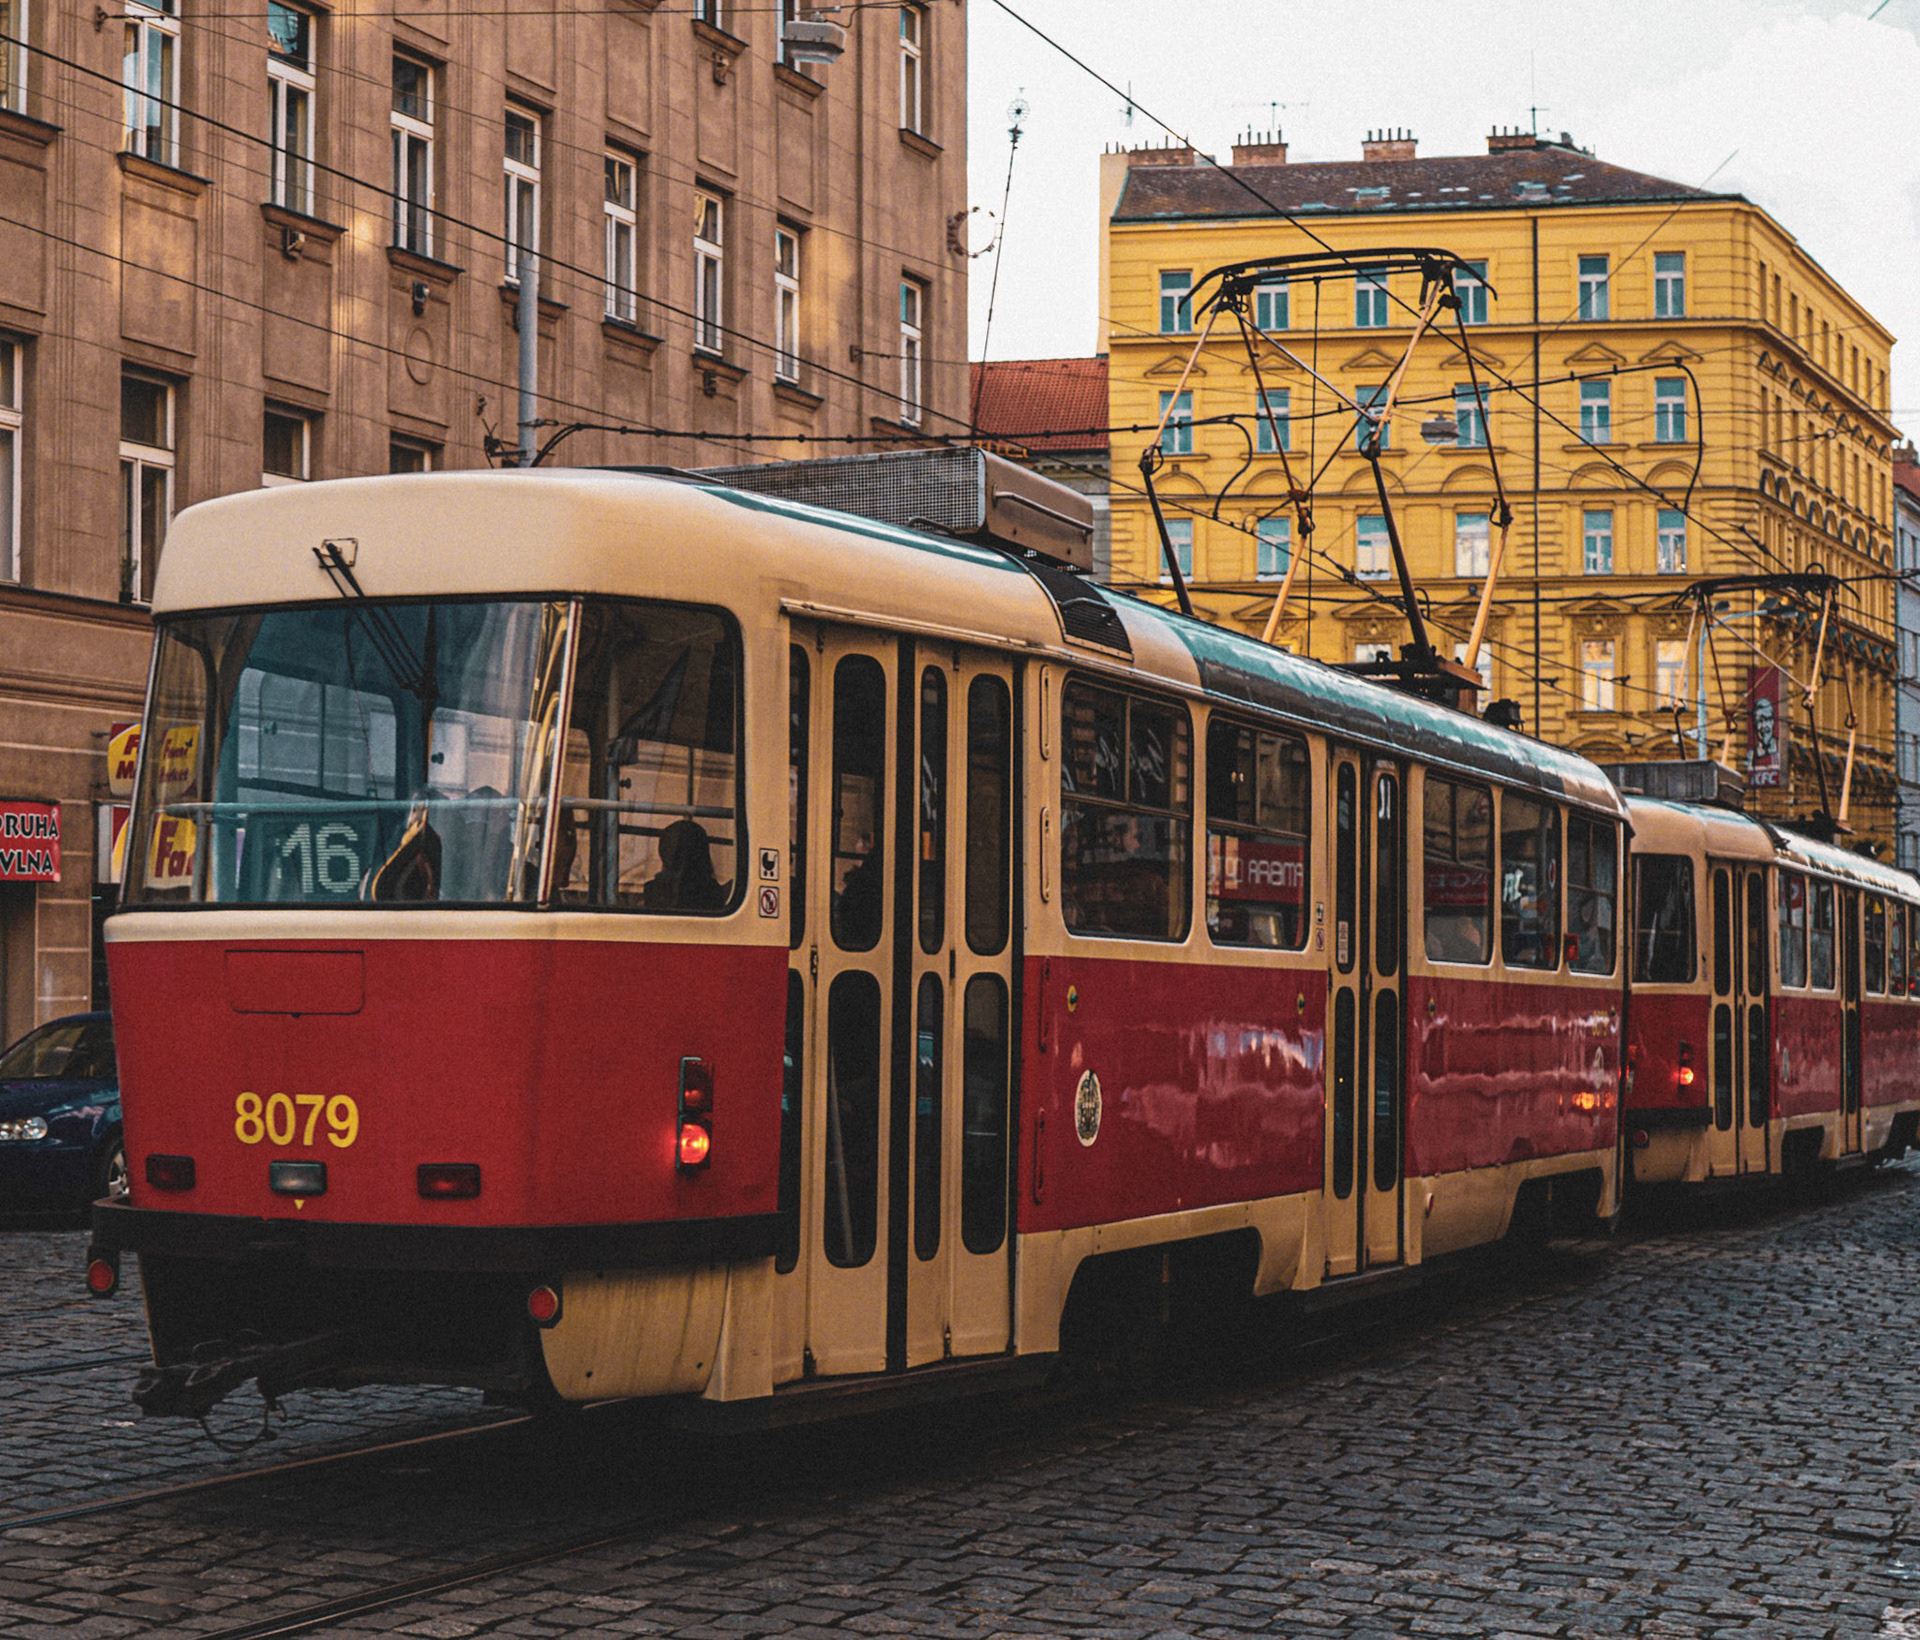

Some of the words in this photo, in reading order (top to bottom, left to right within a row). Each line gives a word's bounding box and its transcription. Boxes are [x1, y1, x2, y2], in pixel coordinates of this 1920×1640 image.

[124, 735, 140, 755] F
[116, 761, 137, 779] M
[1750, 771, 1778, 786] KFC
[0, 849, 54, 875] VLNA
[282, 823, 360, 893] 16
[234, 1091, 359, 1148] 8079
